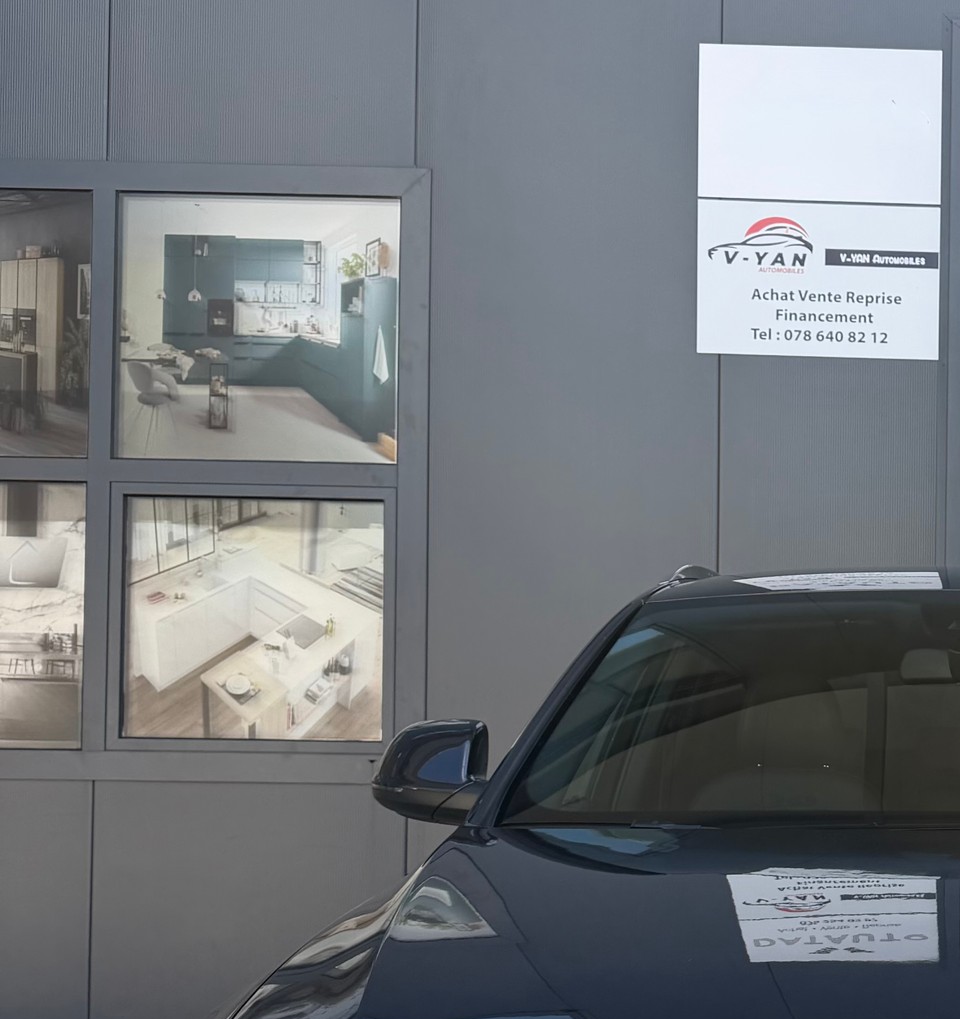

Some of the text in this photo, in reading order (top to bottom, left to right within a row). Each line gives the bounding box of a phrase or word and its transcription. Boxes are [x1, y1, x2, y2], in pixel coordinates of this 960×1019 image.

[839, 252, 871, 264] V-YAN
[758, 267, 805, 275] AUTOMOBILES
[751, 288, 902, 307] Achat Vente Reprise
[775, 308, 874, 324] Financement
[783, 329, 813, 342] 078
[816, 330, 844, 343] 640
[847, 331, 866, 344] 82
[871, 332, 889, 344] 12
